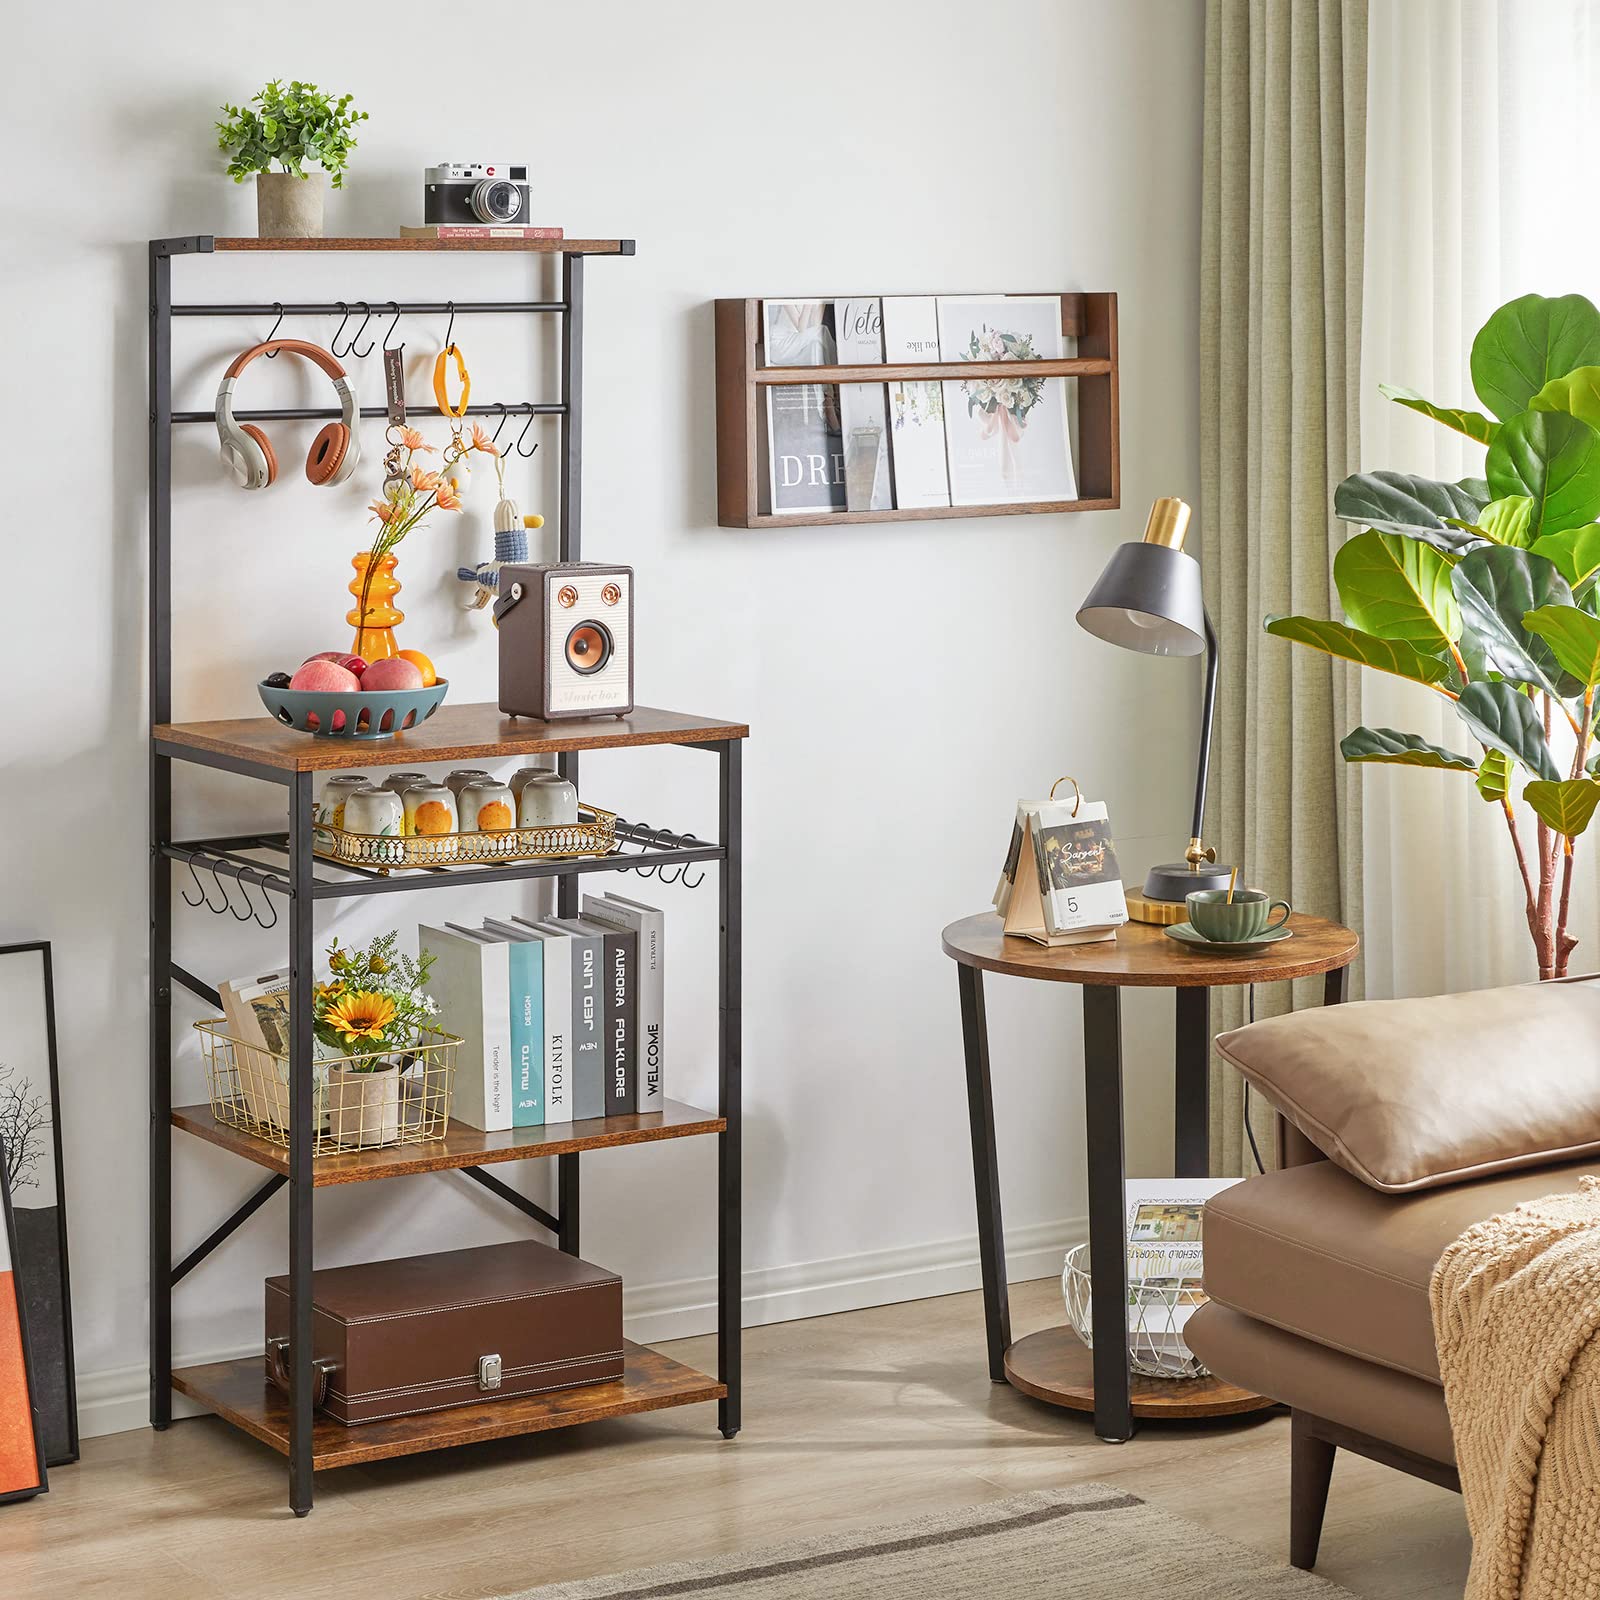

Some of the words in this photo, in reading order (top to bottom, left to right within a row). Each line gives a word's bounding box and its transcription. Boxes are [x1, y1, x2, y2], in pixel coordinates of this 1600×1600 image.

[906, 341, 923, 353] like
[925, 341, 938, 349] ou
[1067, 896, 1079, 913] 5
[583, 949, 593, 989] LIND
[615, 948, 625, 1007] AURORA
[524, 995, 532, 1026] DESIGN
[583, 995, 594, 1031] JED
[492, 1045, 500, 1071] Tender
[579, 1042, 598, 1051] NEW
[615, 1018, 625, 1098] FOLKLORE
[552, 1033, 563, 1105] KINFOLK
[647, 1023, 659, 1097] WELCOME
[492, 1094, 500, 1113] Night
[518, 1099, 537, 1109] NEW
[1168, 1249, 1202, 1259] USEHOLD
